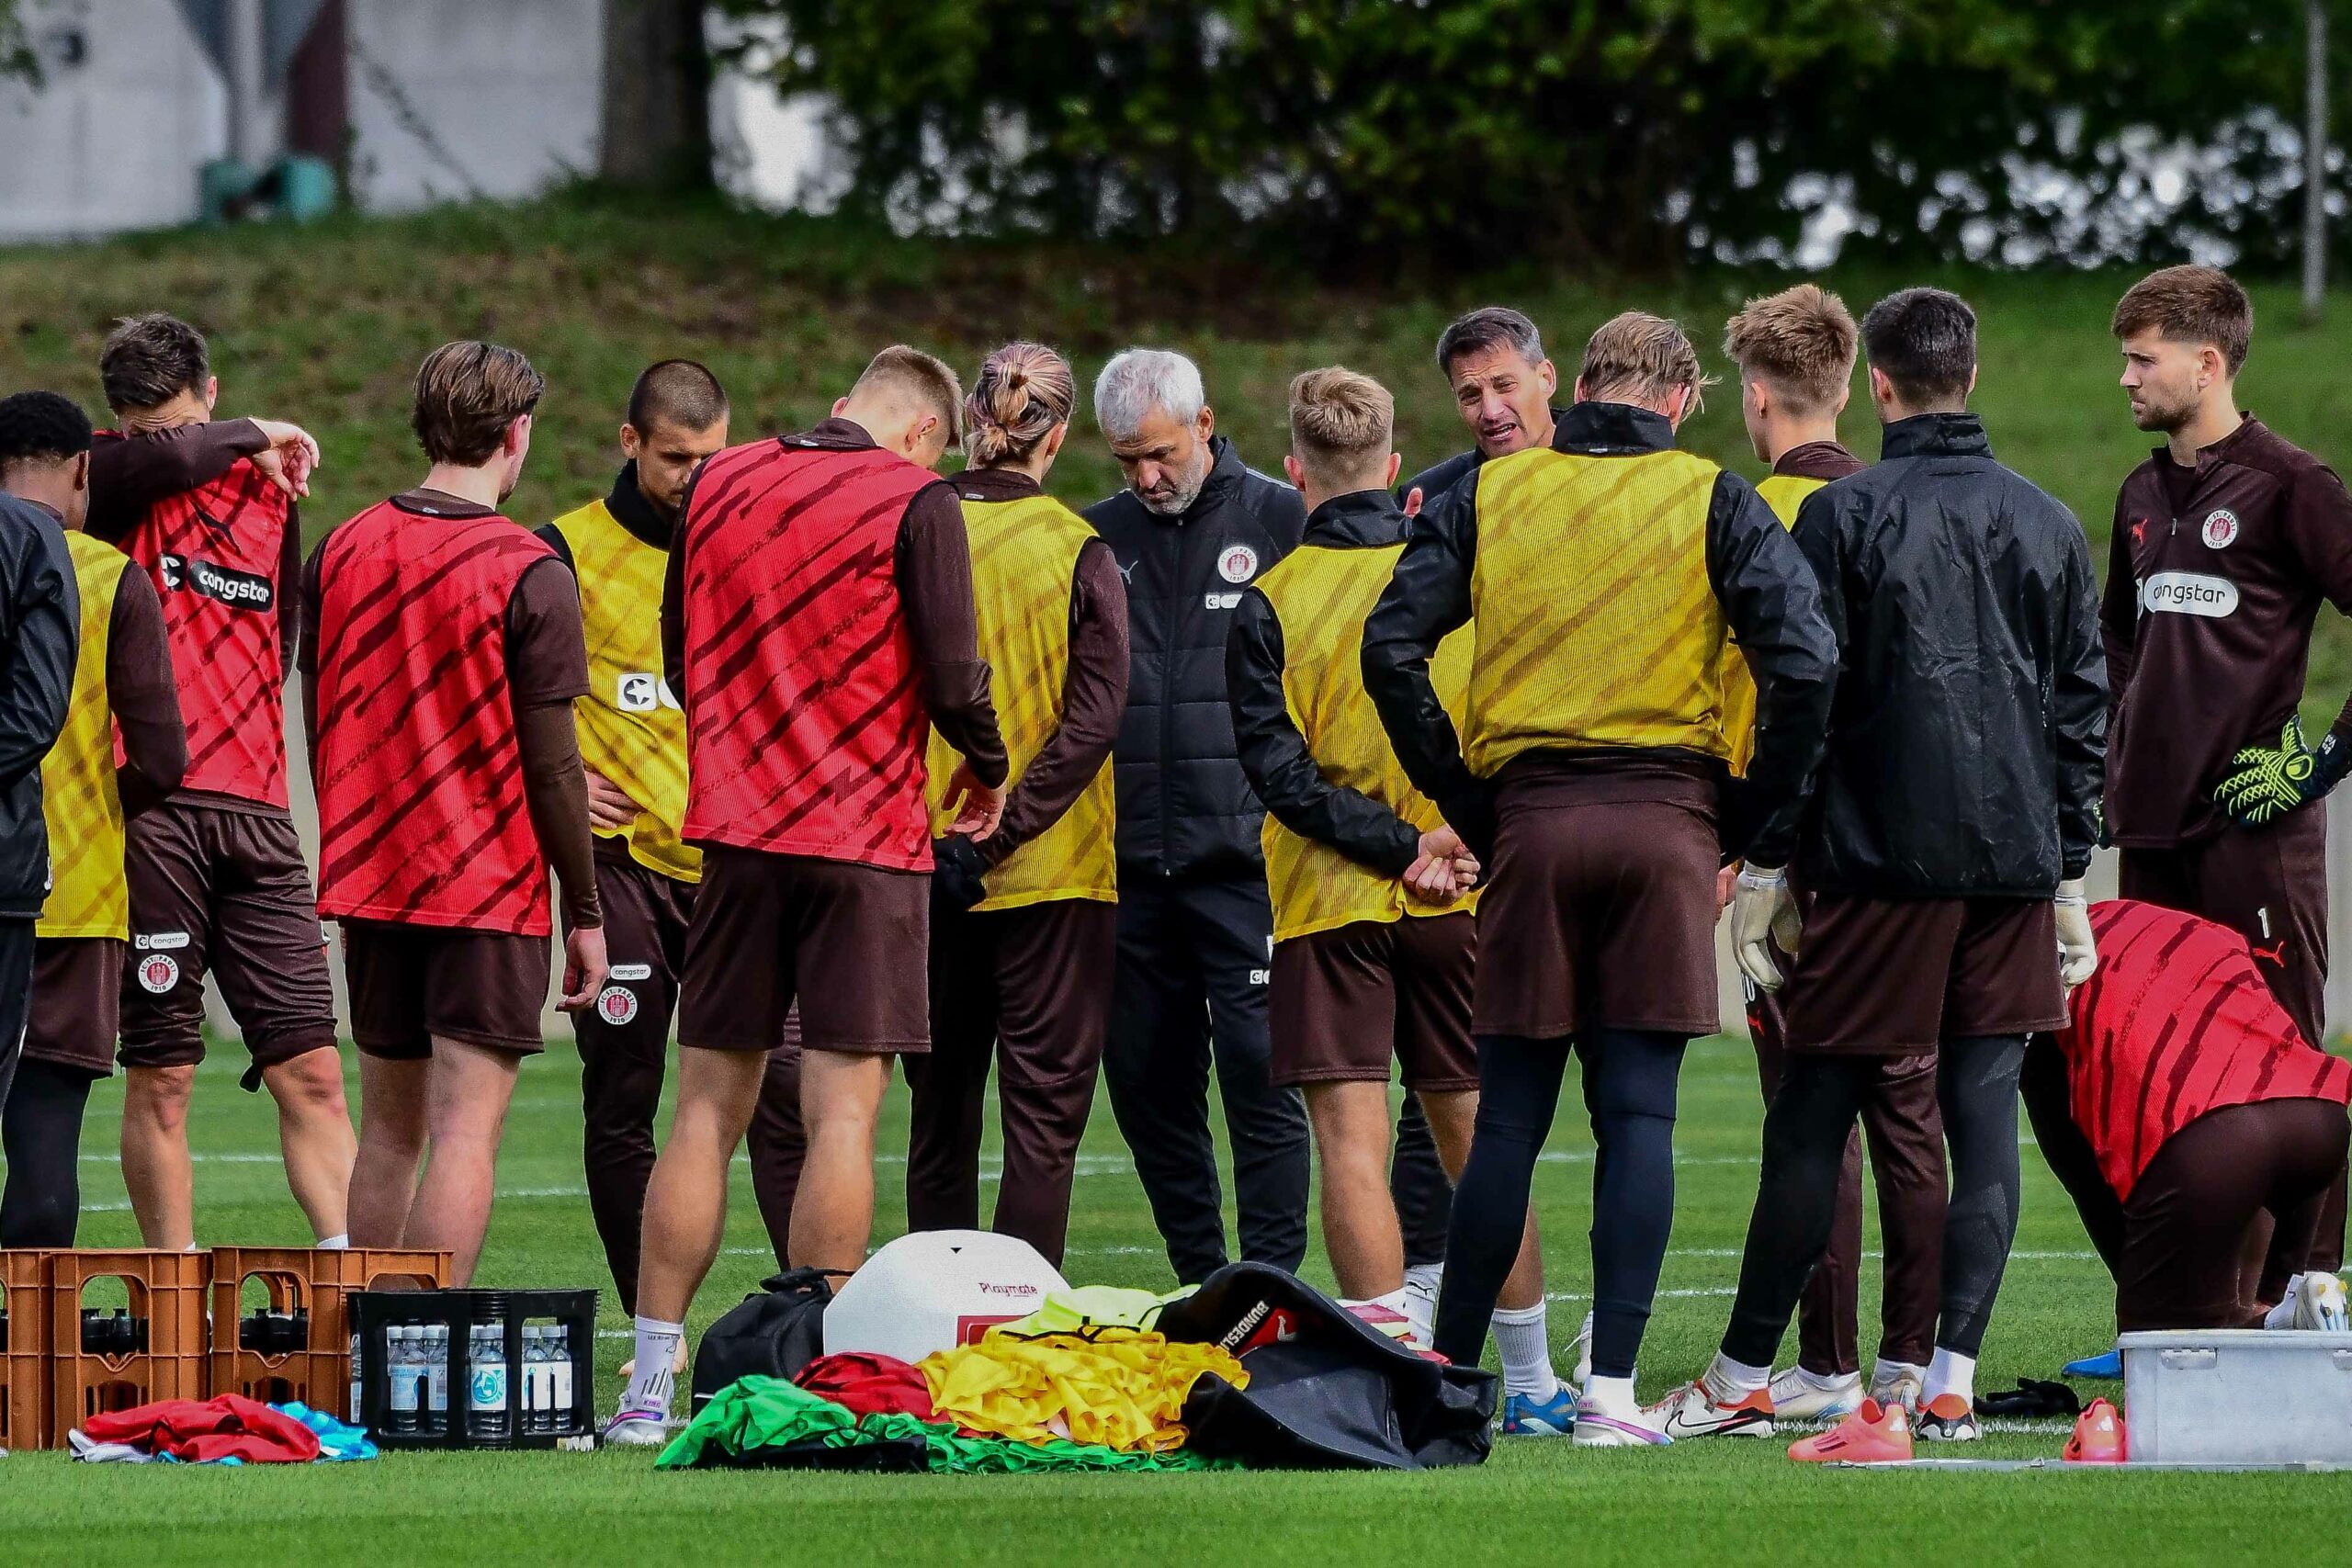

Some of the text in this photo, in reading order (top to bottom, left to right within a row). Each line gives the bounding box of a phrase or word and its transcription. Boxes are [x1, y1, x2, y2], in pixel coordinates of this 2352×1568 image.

[198, 570, 269, 603] congstar
[2257, 908, 2270, 939] 1
[615, 968, 648, 976] congstar
[978, 1282, 1038, 1297] Playmate
